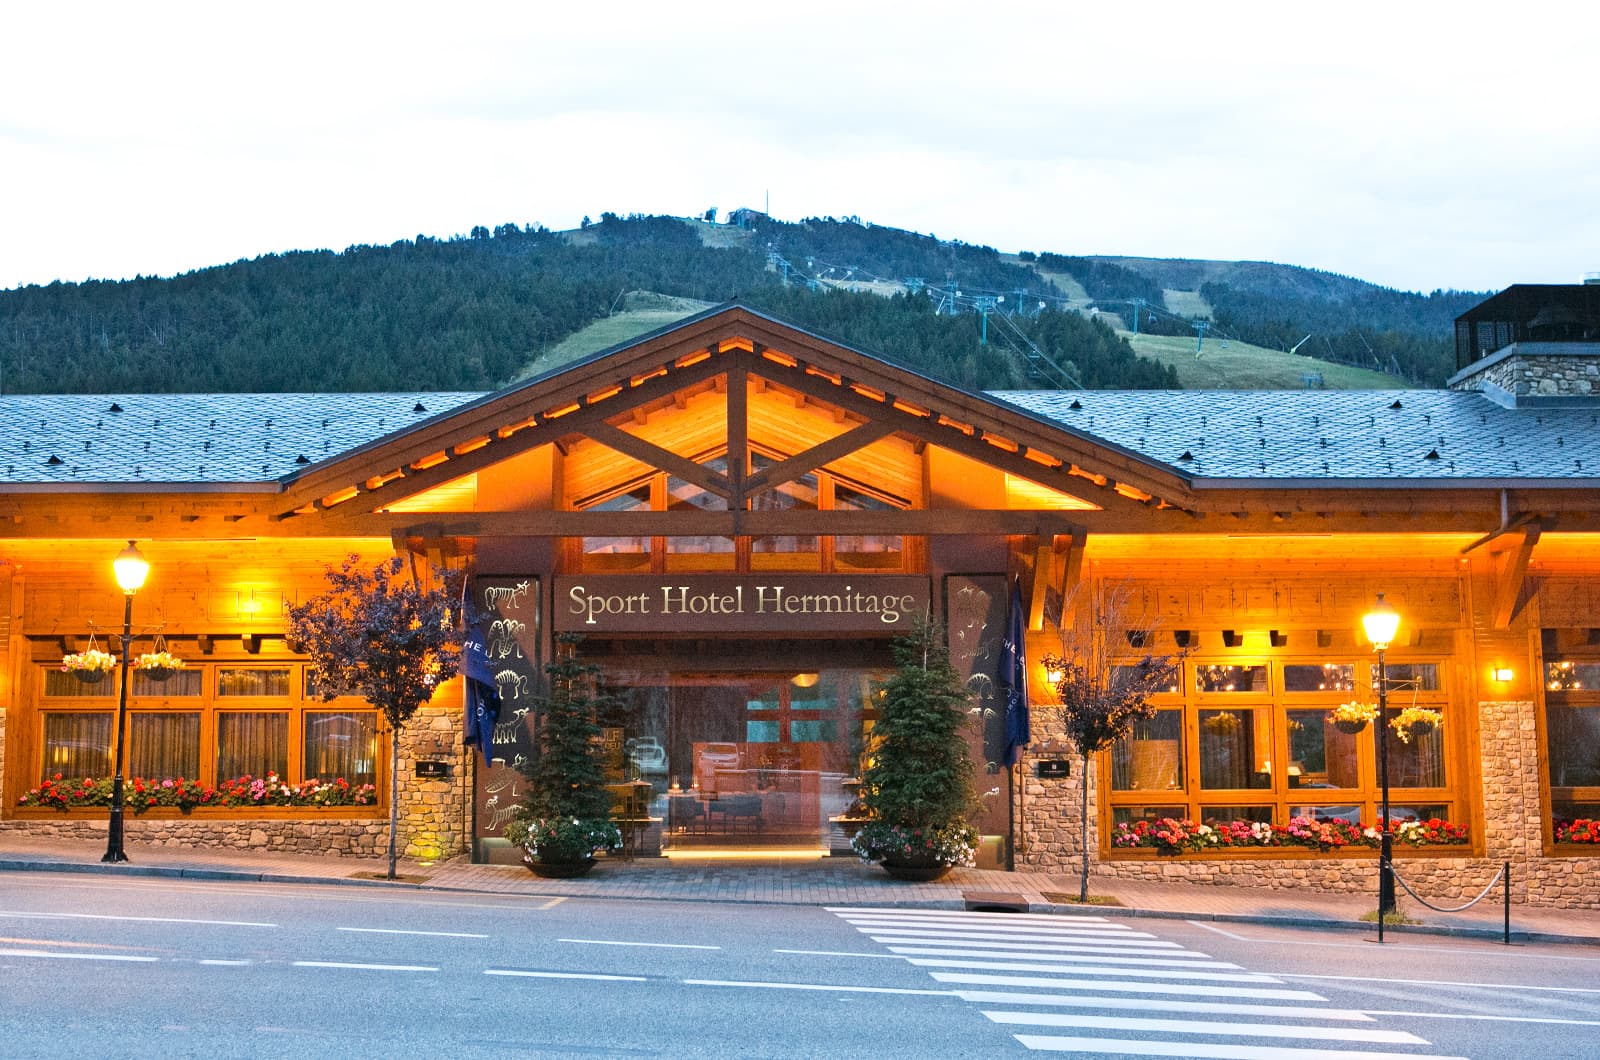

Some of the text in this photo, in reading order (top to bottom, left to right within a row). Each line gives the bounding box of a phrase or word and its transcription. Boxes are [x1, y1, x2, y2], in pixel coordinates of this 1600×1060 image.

[569, 585, 915, 624] Sport Hotel Hermitage
